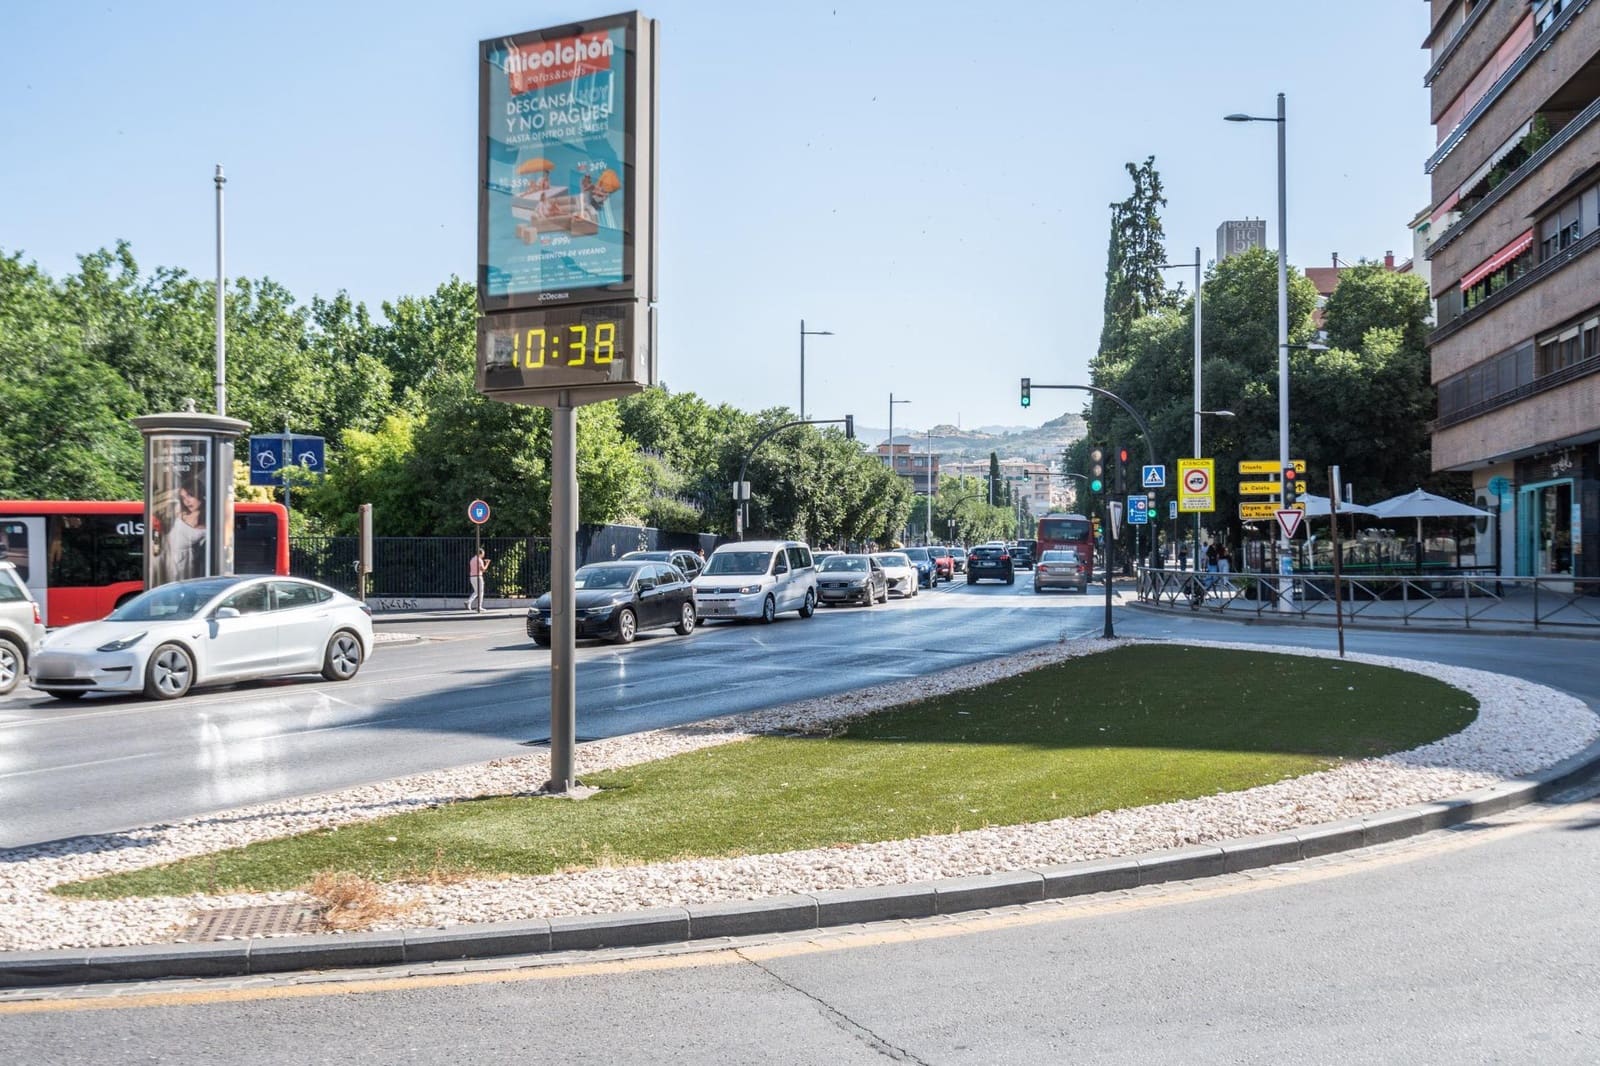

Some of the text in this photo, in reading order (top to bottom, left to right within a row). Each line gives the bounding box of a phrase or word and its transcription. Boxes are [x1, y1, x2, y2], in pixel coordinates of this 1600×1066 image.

[506, 92, 576, 115] DESCANSA
[506, 103, 609, 132] Y NO PAGUES
[506, 133, 530, 145] HASTA
[532, 128, 564, 140] DENTRO
[566, 126, 577, 136] DE
[1228, 221, 1264, 229] HOTEL
[537, 292, 570, 301] JCDecaux
[513, 323, 615, 368] 10:38
[116, 520, 145, 535] als
